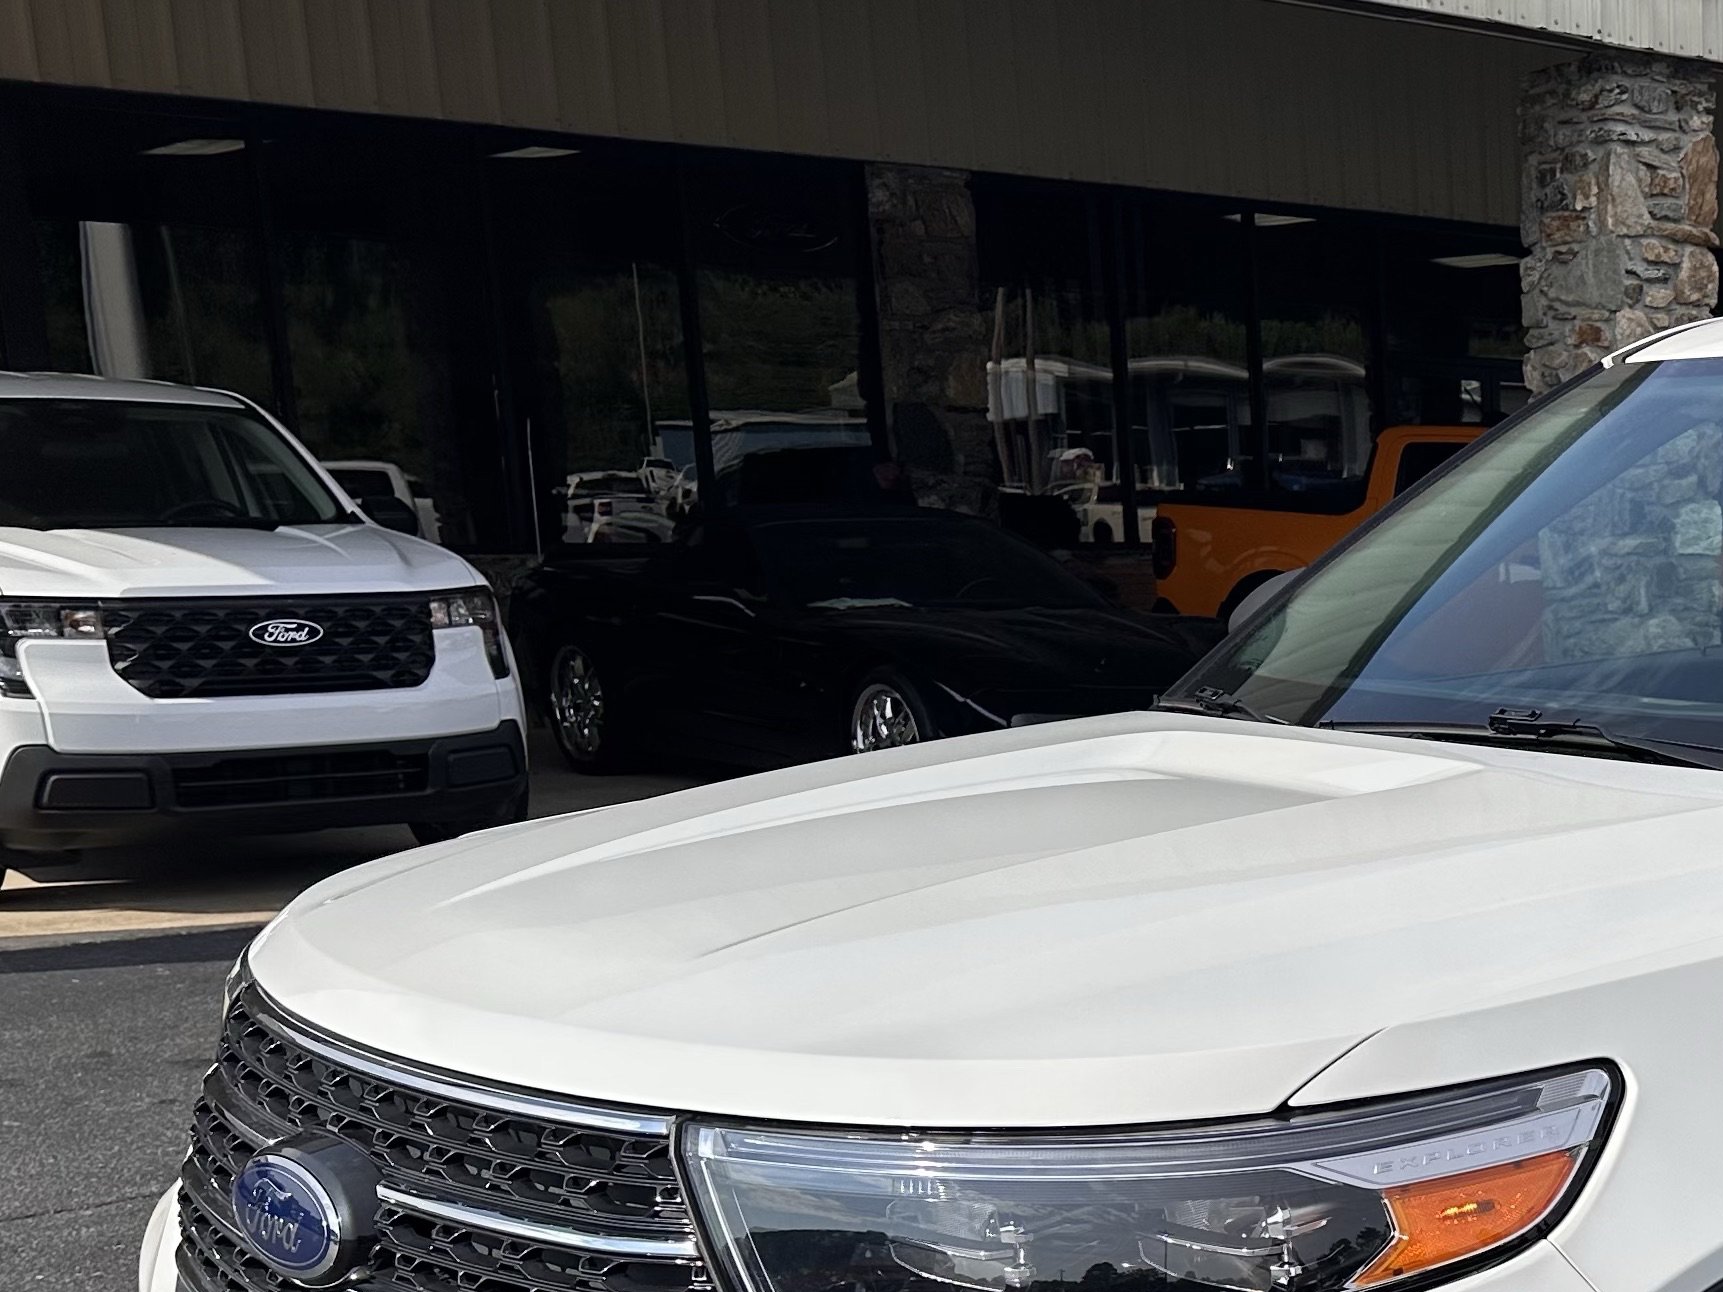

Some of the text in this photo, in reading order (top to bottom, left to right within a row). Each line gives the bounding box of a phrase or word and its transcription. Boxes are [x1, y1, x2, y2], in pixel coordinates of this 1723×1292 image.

[264, 623, 309, 642] Ford
[1372, 1125, 1559, 1174] EXPLORER
[246, 1178, 302, 1253] Ford
